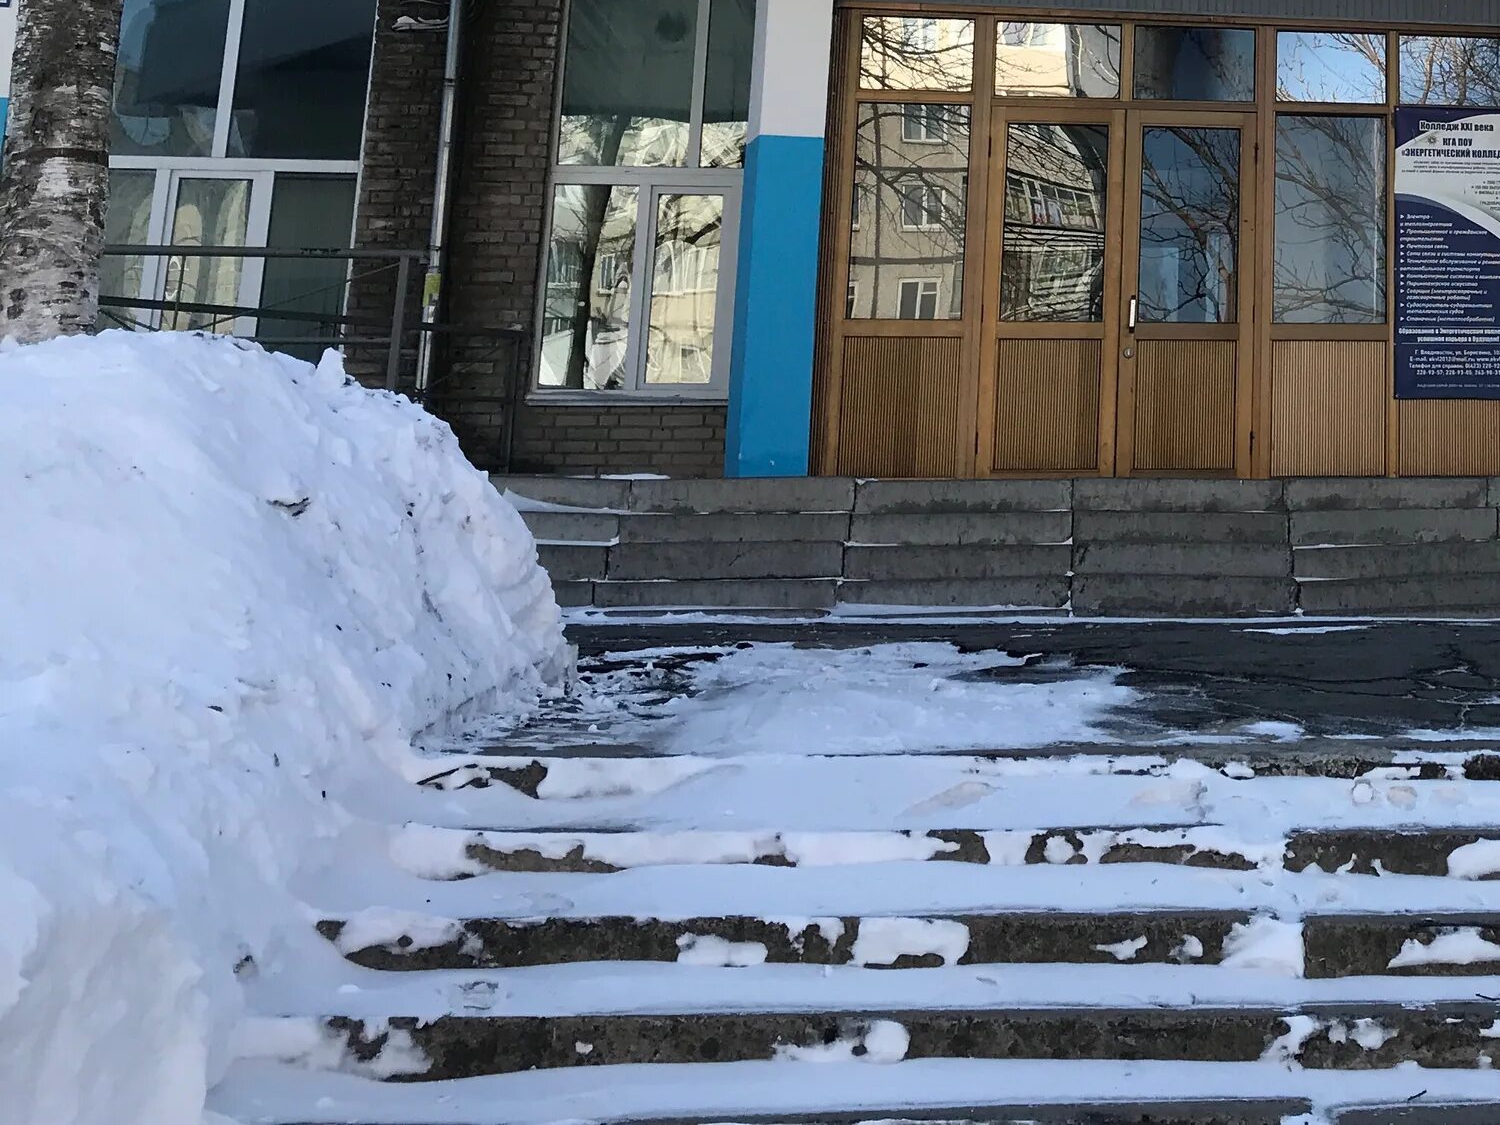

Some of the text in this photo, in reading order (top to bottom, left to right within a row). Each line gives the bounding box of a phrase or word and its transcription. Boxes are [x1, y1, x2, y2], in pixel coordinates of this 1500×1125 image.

[1420, 122, 1494, 132] Колледж XXI века
[1458, 138, 1473, 146] ПОУ
